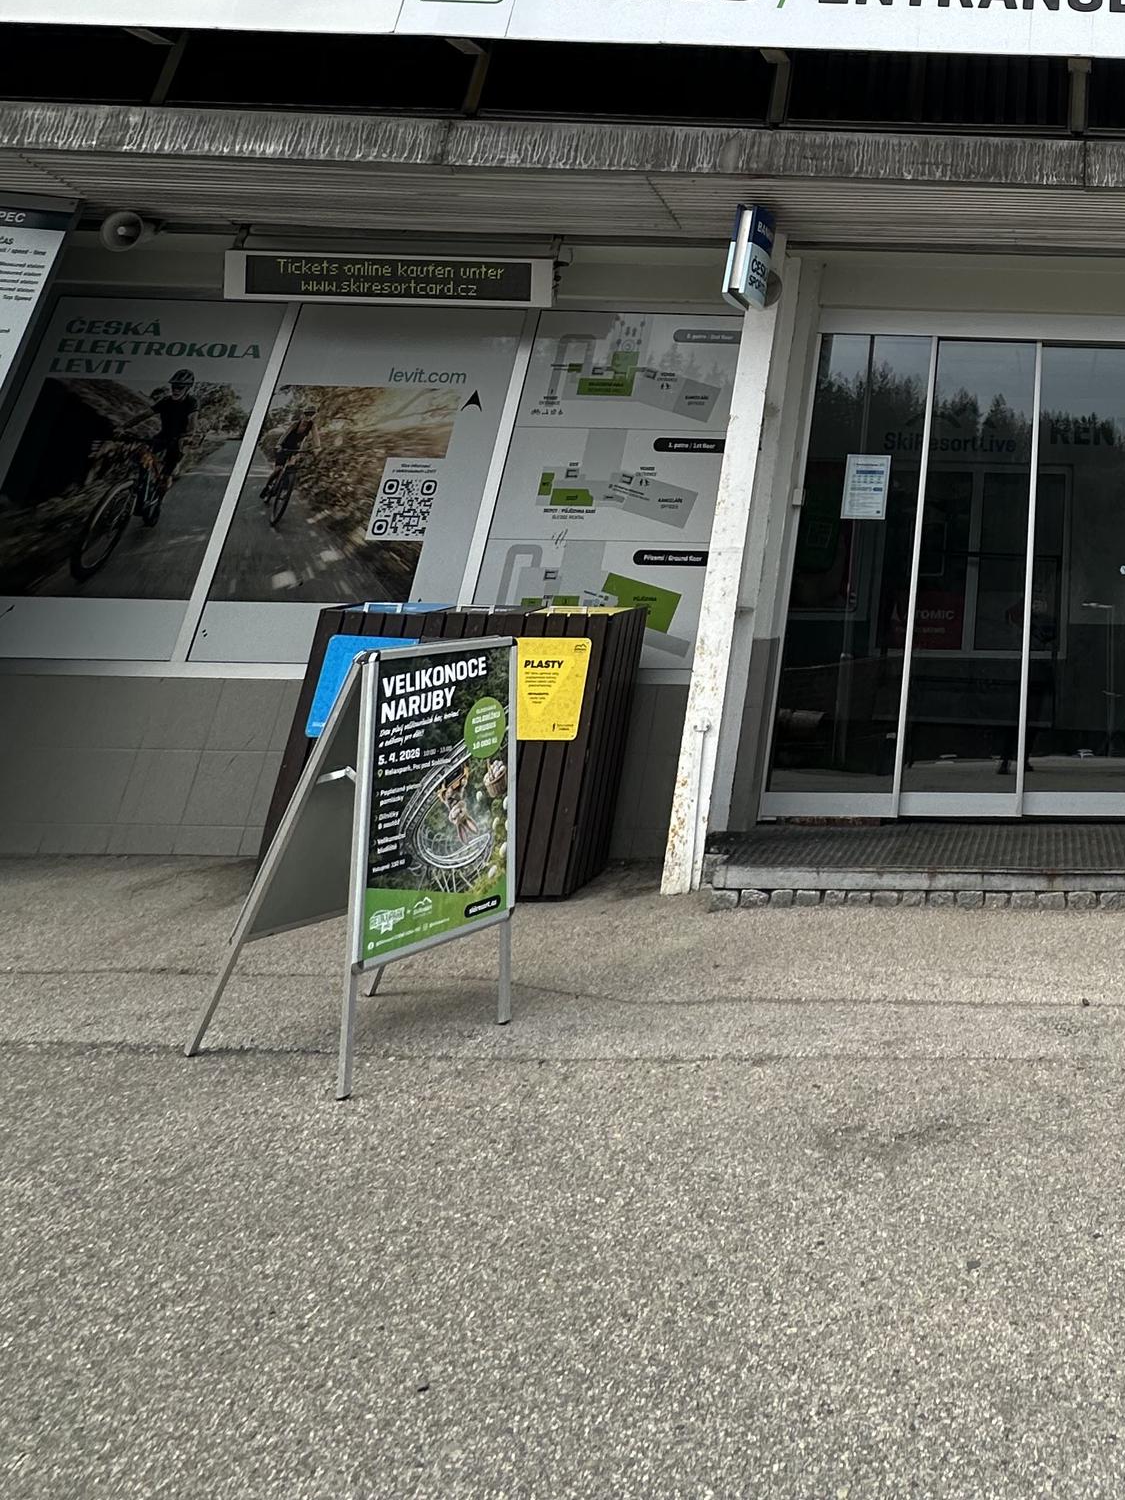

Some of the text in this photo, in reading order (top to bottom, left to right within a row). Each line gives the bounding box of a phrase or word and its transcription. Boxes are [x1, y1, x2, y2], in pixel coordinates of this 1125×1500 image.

[277, 259, 338, 274] Tickets
[344, 261, 392, 276] online
[461, 264, 504, 279] unter
[301, 279, 477, 296] www.skiresortcard.cz
[66, 316, 161, 336] ČESKÁ
[57, 338, 261, 359] ELEKTROKOLA
[49, 357, 131, 374] LEVIT
[388, 367, 467, 384] levit.com
[524, 660, 564, 668] PLASTY
[382, 656, 487, 698] VELIKONOCE
[381, 685, 456, 724] NARUBY
[378, 754, 387, 766] 5.
[389, 752, 398, 763] 4.
